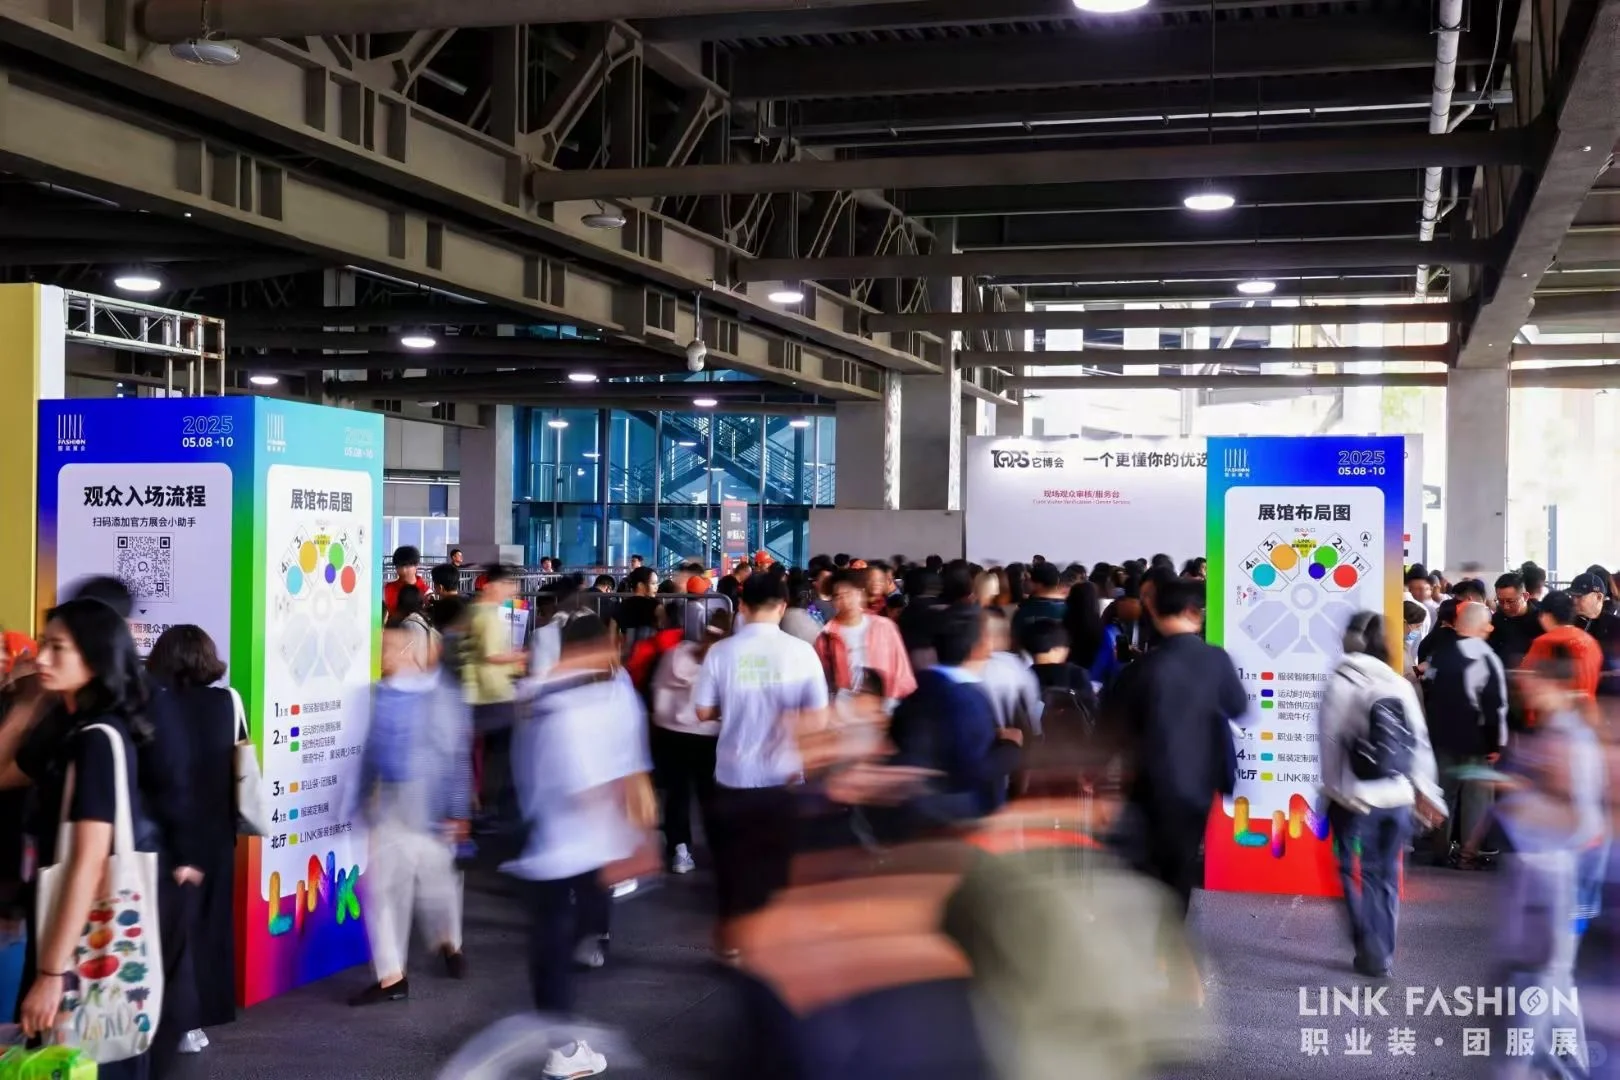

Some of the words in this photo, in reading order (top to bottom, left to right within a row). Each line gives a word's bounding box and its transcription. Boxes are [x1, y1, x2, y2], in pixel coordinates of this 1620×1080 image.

[183, 416, 233, 434] 2025
[1032, 457, 1064, 468] 它博会
[1338, 450, 1385, 465] 2025
[84, 485, 206, 507] 观众入场流程
[290, 488, 353, 512] 展馆布局图
[1044, 490, 1120, 498] 现场观众审核/服务台
[1258, 504, 1351, 521] 展馆布局图
[92, 516, 197, 528] 扫码添加官方展会小助手
[271, 834, 288, 850] 北厅
[268, 850, 361, 937] LINK
